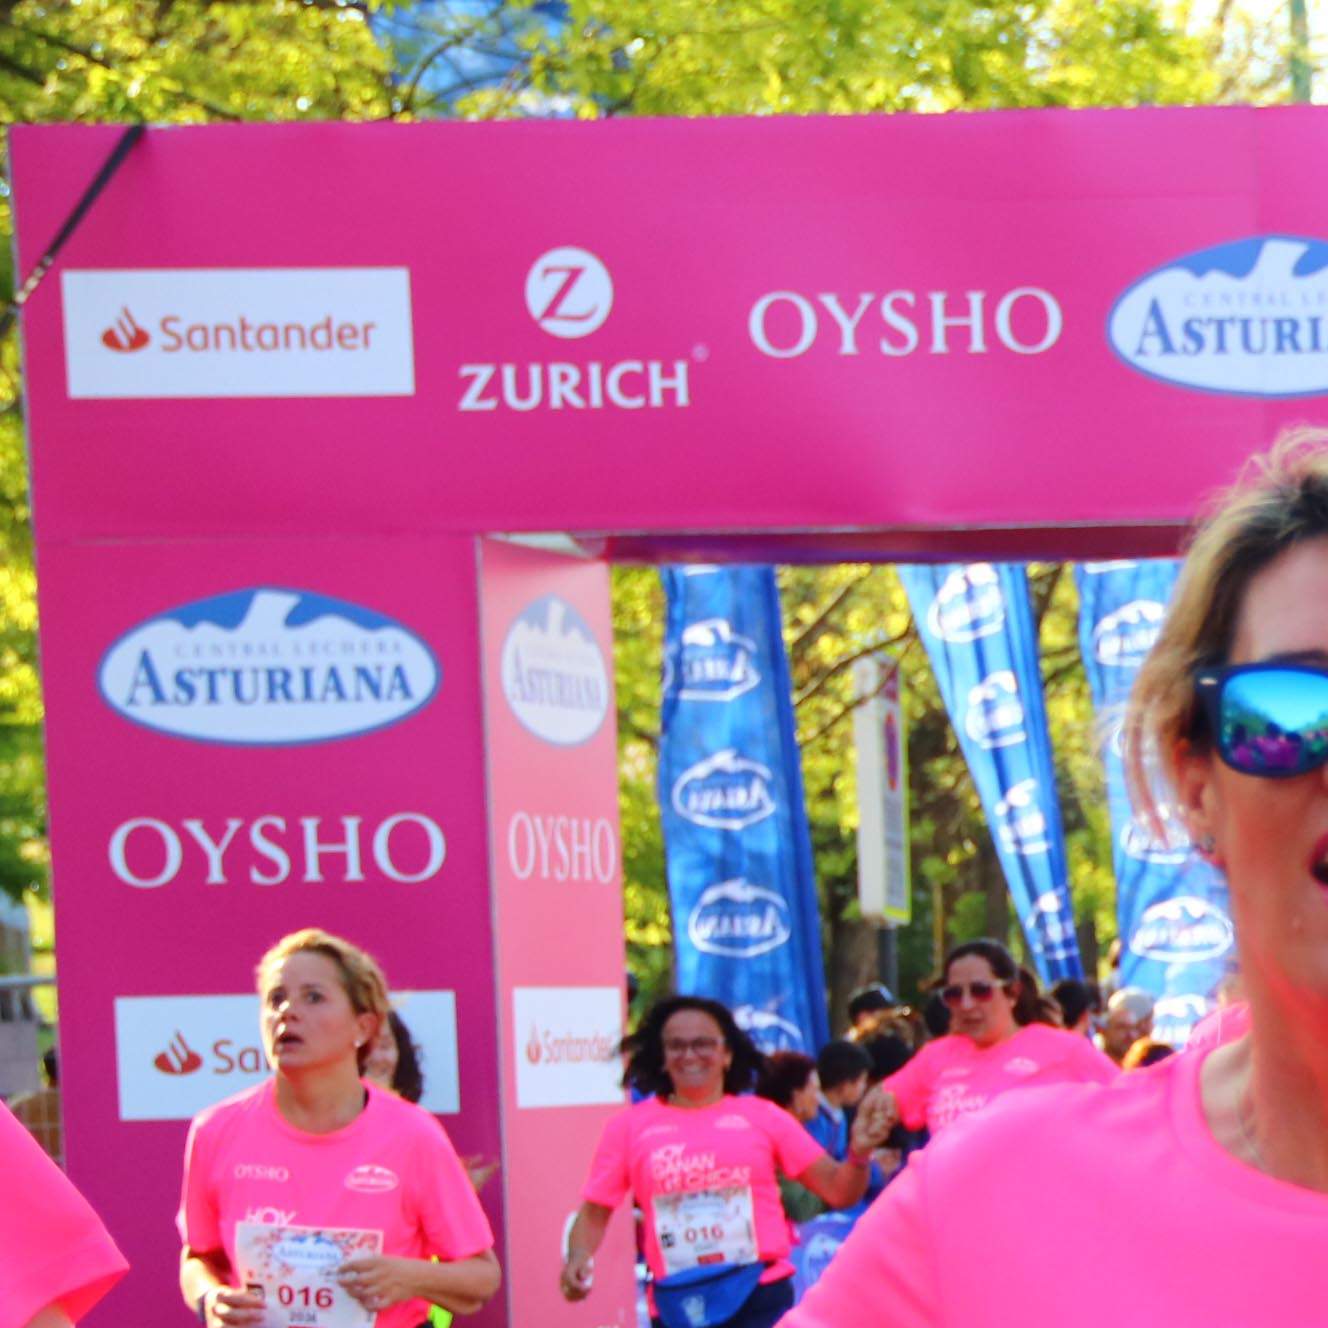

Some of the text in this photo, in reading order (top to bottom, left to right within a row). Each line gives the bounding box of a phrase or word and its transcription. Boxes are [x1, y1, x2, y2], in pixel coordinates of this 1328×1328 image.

[160, 315, 377, 353] Santander
[748, 286, 1063, 359] OYSHO
[457, 361, 691, 412] ZURICH
[125, 647, 416, 707] ASTURIANA
[108, 811, 447, 889] OYSHO
[507, 810, 618, 885] OYSHO
[213, 1039, 271, 1075] Sa
[541, 1030, 617, 1066] Santander
[684, 1224, 725, 1243] 016
[278, 1284, 334, 1310] 016
